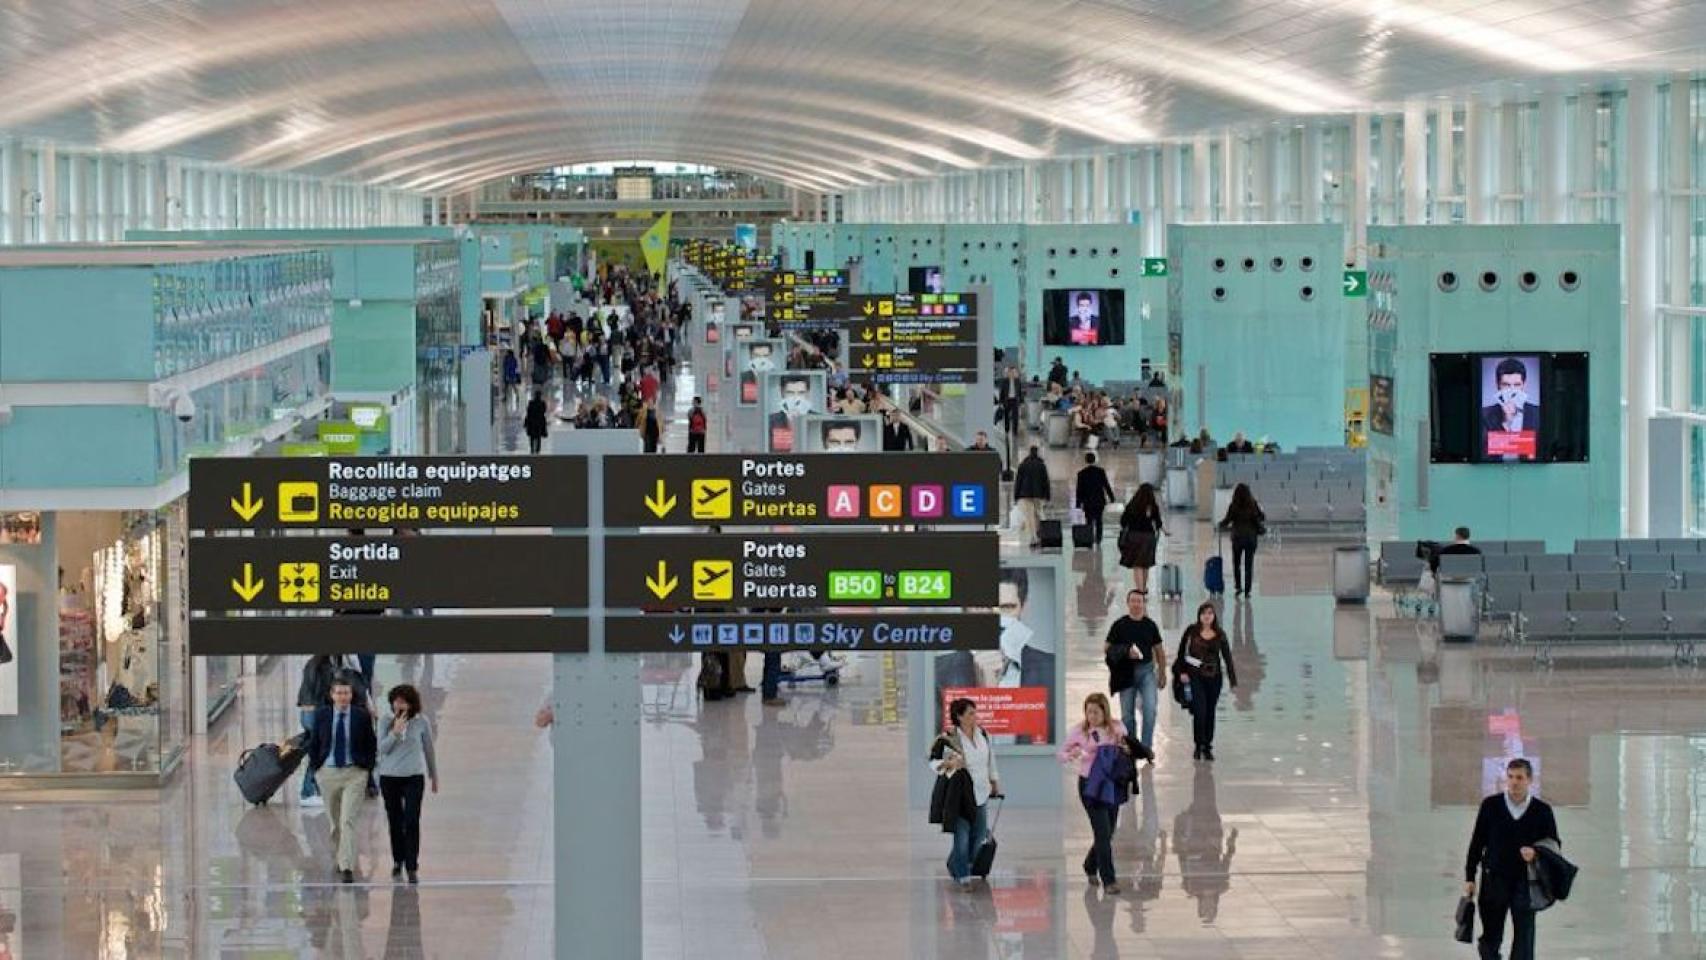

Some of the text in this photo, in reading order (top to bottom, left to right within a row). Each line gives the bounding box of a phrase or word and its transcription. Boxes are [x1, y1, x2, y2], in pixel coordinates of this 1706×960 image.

[329, 461, 532, 482] Recollida equipatges
[742, 459, 806, 478] Portes
[329, 482, 442, 502] Baggage claim
[742, 480, 786, 497] Gates
[742, 499, 817, 517] Puertas
[835, 490, 976, 512] A C D E
[329, 501, 519, 523] Recogida equipajes
[329, 542, 400, 561] Sortida
[743, 540, 806, 558] Portes
[329, 564, 358, 580] Exit
[742, 561, 786, 578] Gates
[329, 582, 389, 601] Salida
[743, 581, 817, 598] Puertas
[834, 575, 877, 594] B50
[904, 575, 945, 594] B24
[820, 623, 953, 648] Sky Centre
